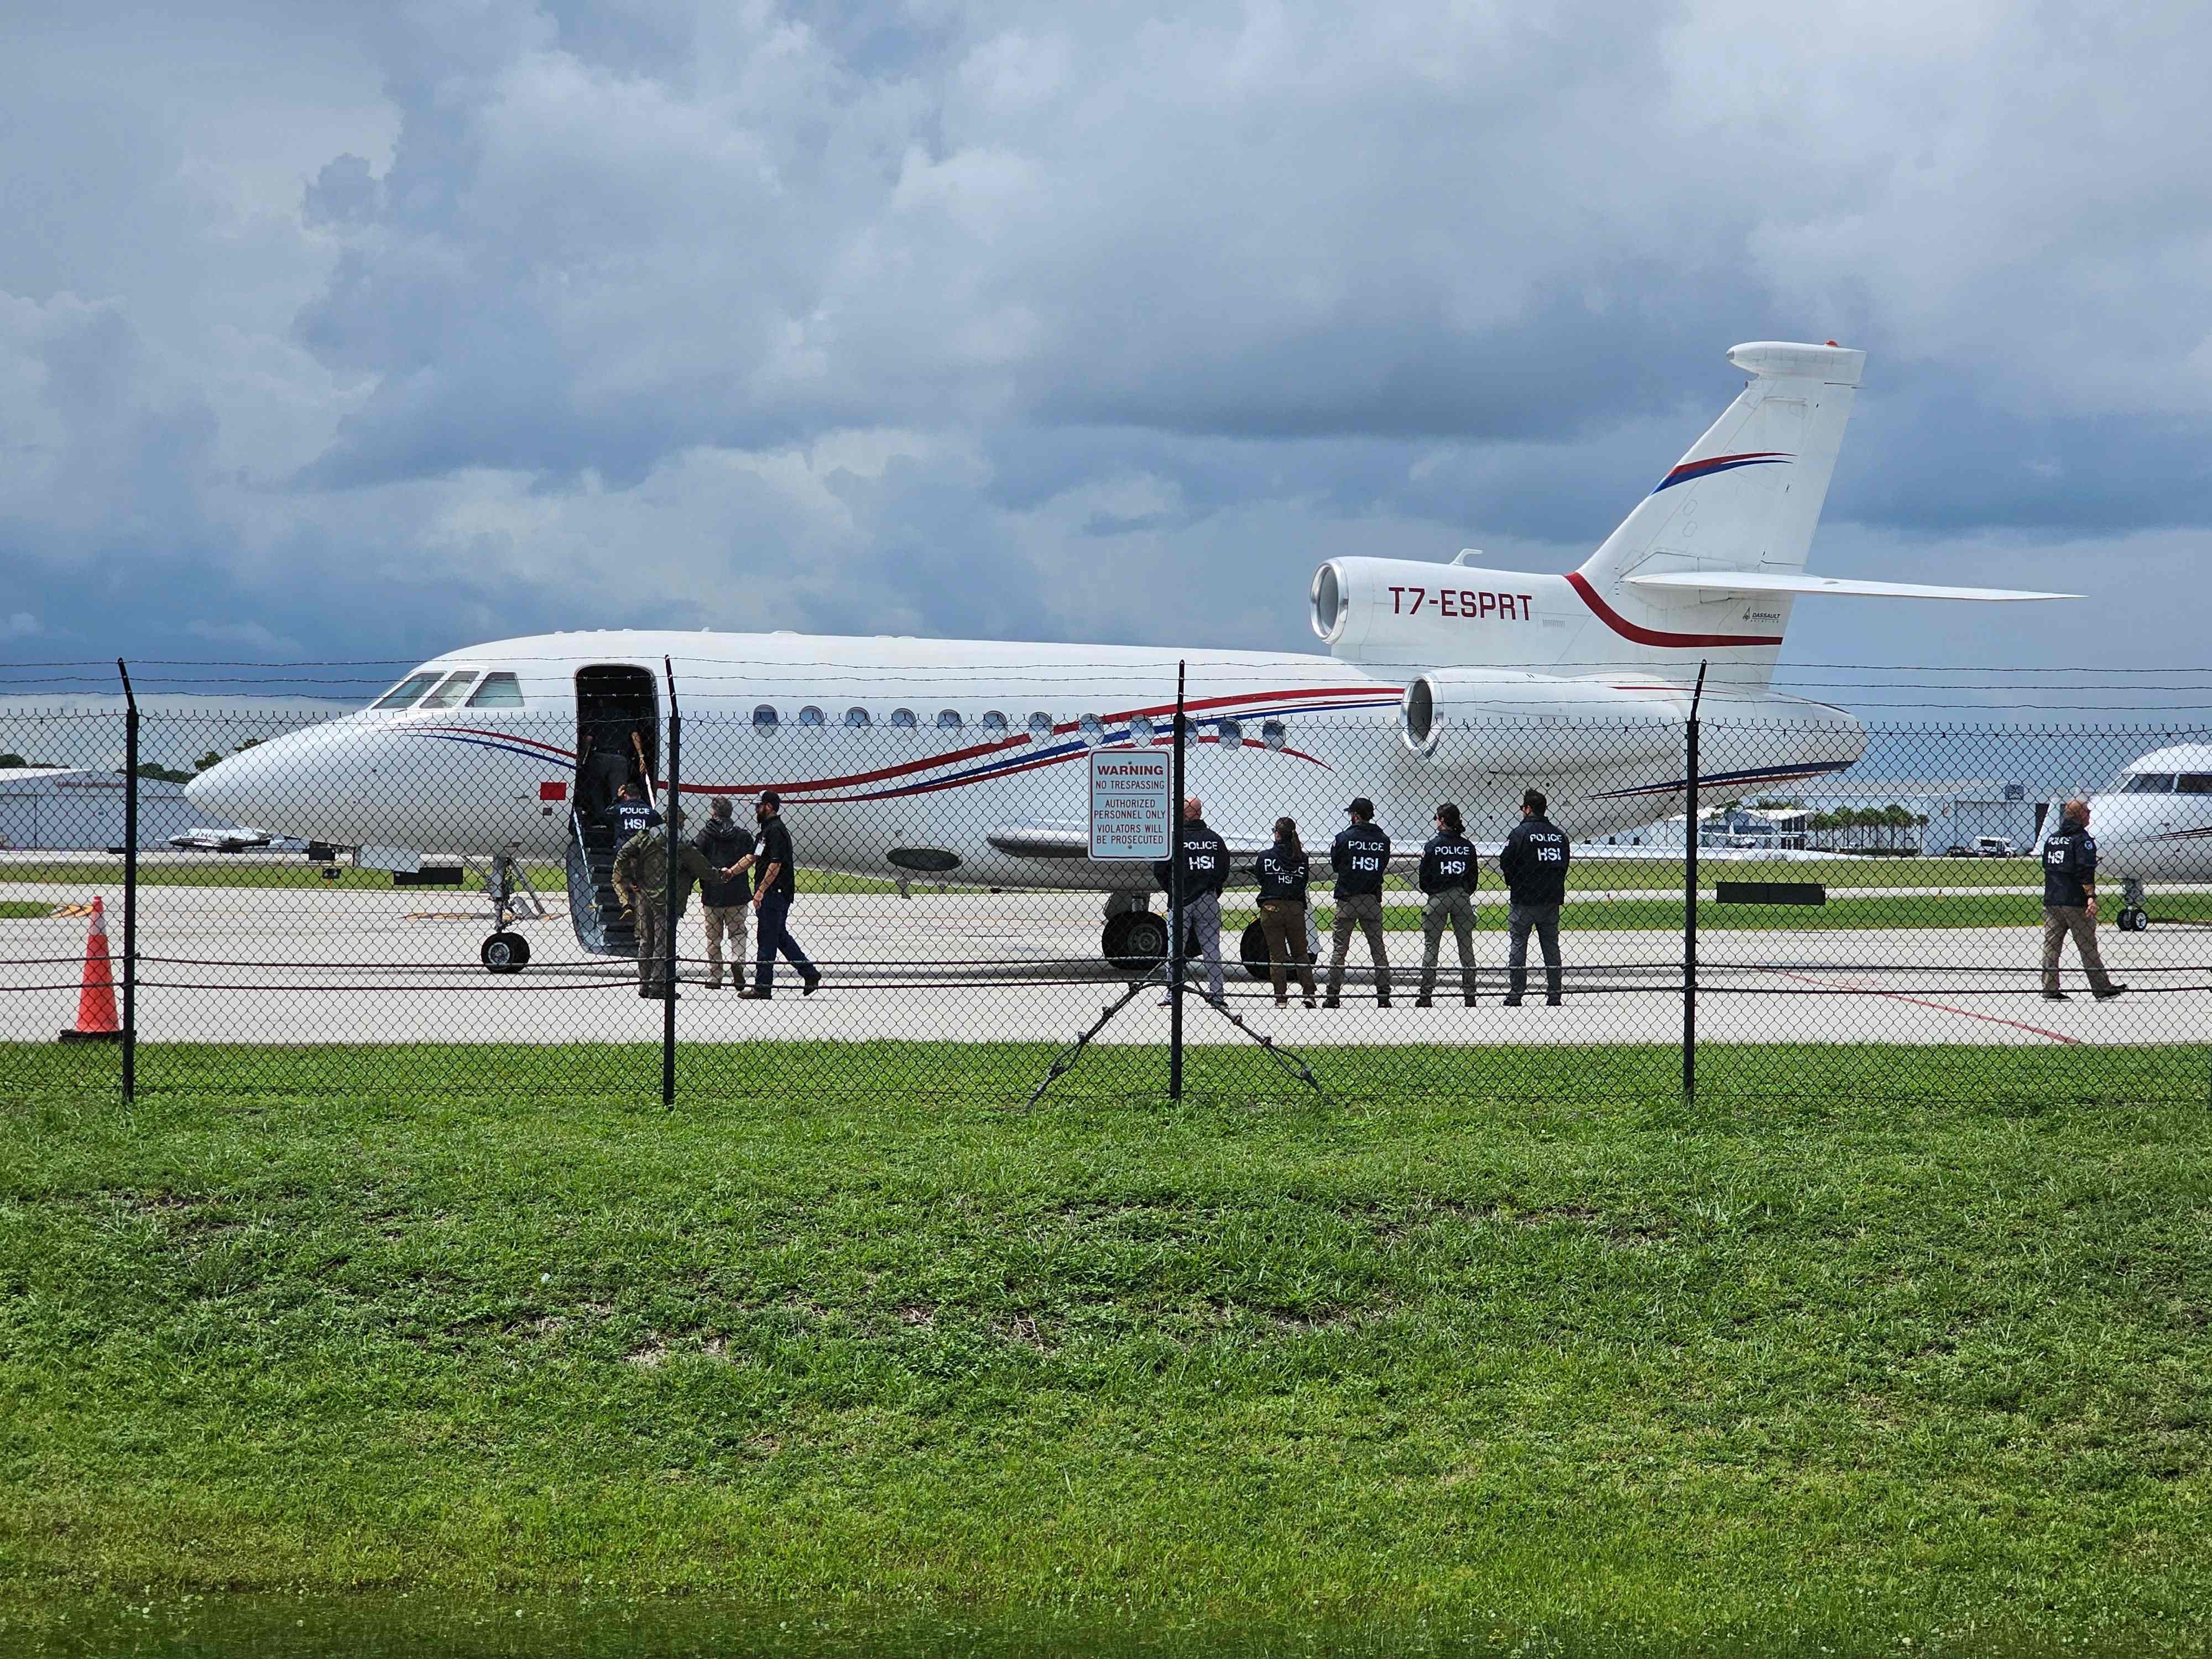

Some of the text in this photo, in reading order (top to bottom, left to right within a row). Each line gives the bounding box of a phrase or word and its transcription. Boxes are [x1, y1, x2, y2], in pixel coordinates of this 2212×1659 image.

[1389, 587, 1532, 621] T7-ESPRT
[1097, 765, 1164, 775] WARNING
[1096, 780, 1164, 789] NO TRESPASSING
[1105, 799, 1155, 808] AUTHORIZED
[1094, 810, 1166, 819] PERSONNEL ONLY
[624, 818, 646, 830] HSI
[1097, 824, 1164, 833] VIOLATORS WILL
[1097, 836, 1164, 844] BE PROSECUTED
[1530, 833, 1562, 842] POLICE
[1183, 841, 1218, 850] POLICE
[1348, 841, 1384, 851] POLICE
[1434, 846, 1469, 855] POLICE
[1537, 848, 1561, 861] HSI
[2048, 851, 2064, 864] HSI
[1189, 855, 1214, 870] HSI
[1352, 856, 1379, 871] HSI
[1441, 861, 1465, 874] HSI
[1278, 875, 1293, 884] HSI
